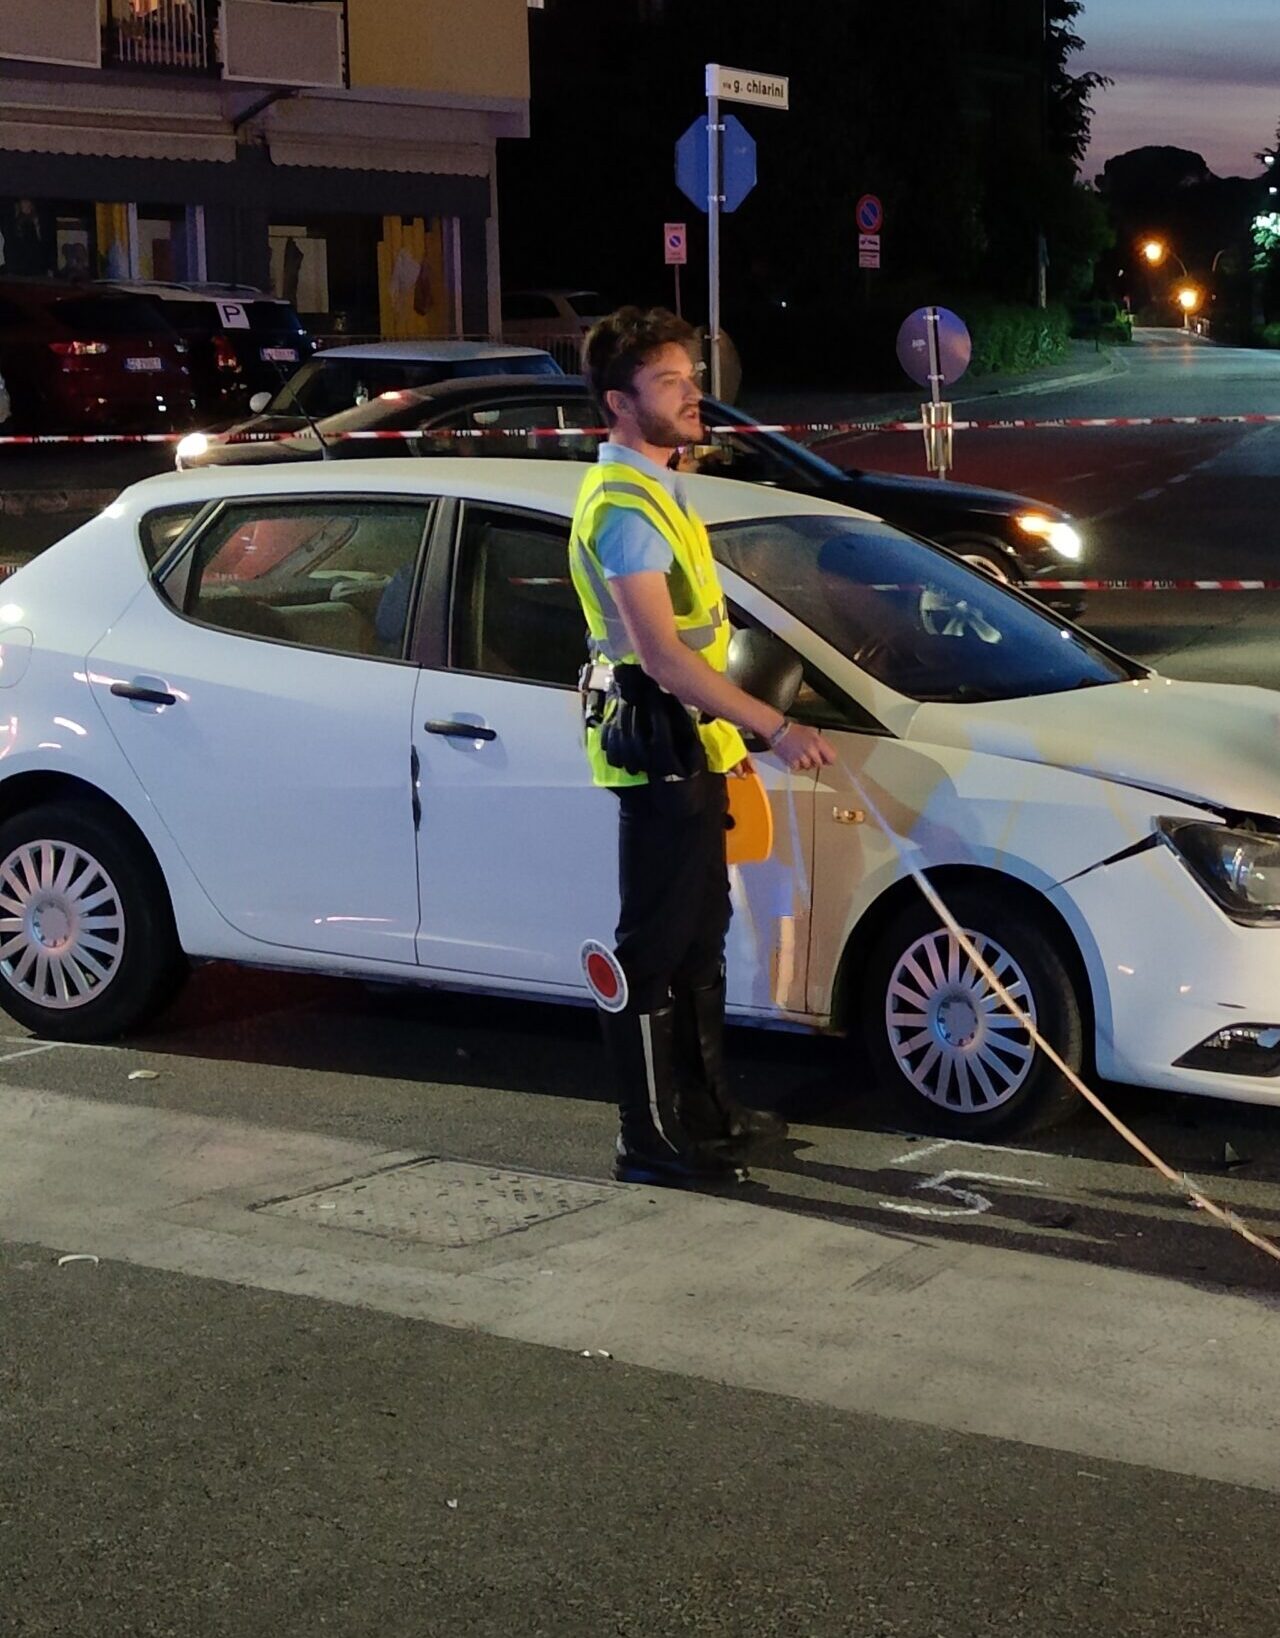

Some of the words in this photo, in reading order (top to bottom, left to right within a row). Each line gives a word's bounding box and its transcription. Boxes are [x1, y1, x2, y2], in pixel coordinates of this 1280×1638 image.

[733, 80, 744, 93] g.
[746, 79, 784, 98] chiarini
[222, 304, 241, 323] P
